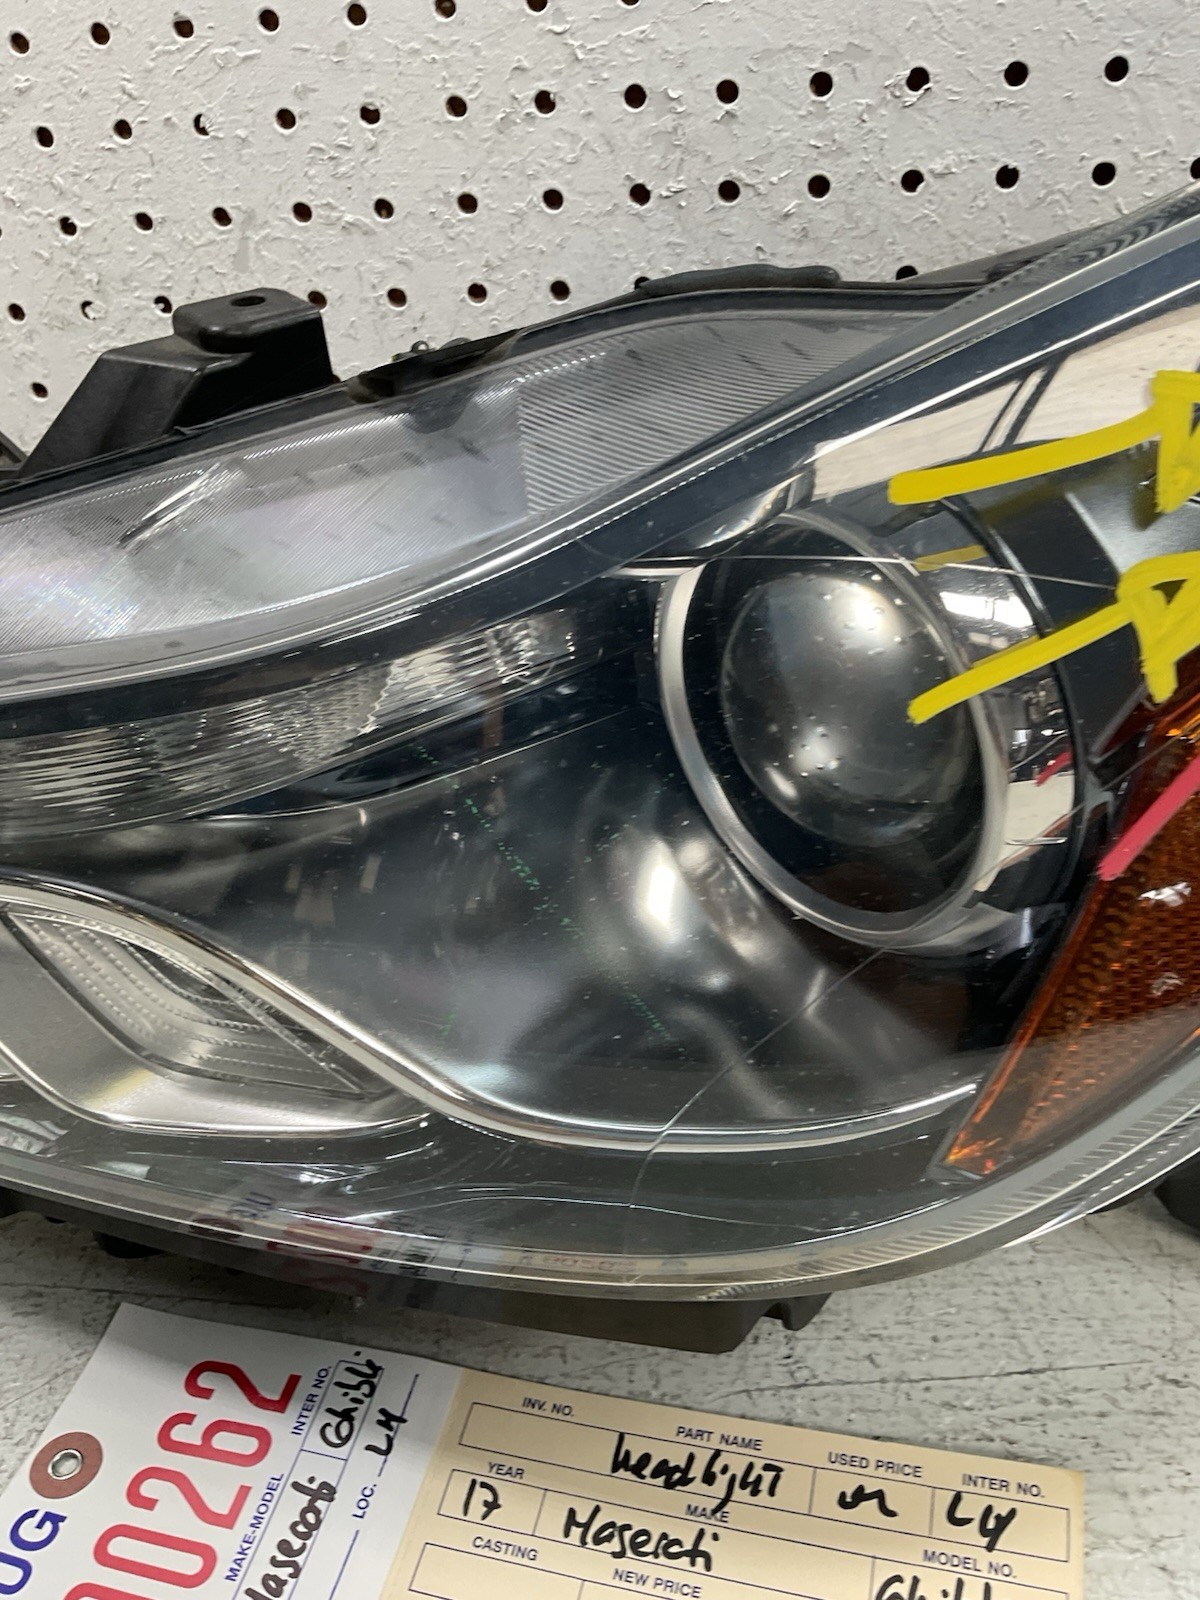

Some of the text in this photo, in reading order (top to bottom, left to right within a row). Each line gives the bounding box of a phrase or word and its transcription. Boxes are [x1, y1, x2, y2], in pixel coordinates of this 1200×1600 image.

[290, 1366, 333, 1436] INTER NO.
[521, 1396, 575, 1417] INV. NO.
[676, 1426, 763, 1451] PART NAME
[488, 1461, 525, 1480] YEAR
[828, 1451, 924, 1478] USED PRICE
[962, 1473, 1046, 1498] INTER NO.
[351, 1483, 379, 1520] LOC.
[462, 1478, 502, 1521] 17
[685, 1504, 730, 1524] MAKE
[224, 1473, 285, 1583] MAKE-MODEL
[472, 1536, 538, 1562] CASTING
[923, 1549, 1018, 1579] MODEL NO.
[611, 1567, 703, 1599] NEW PRICE
